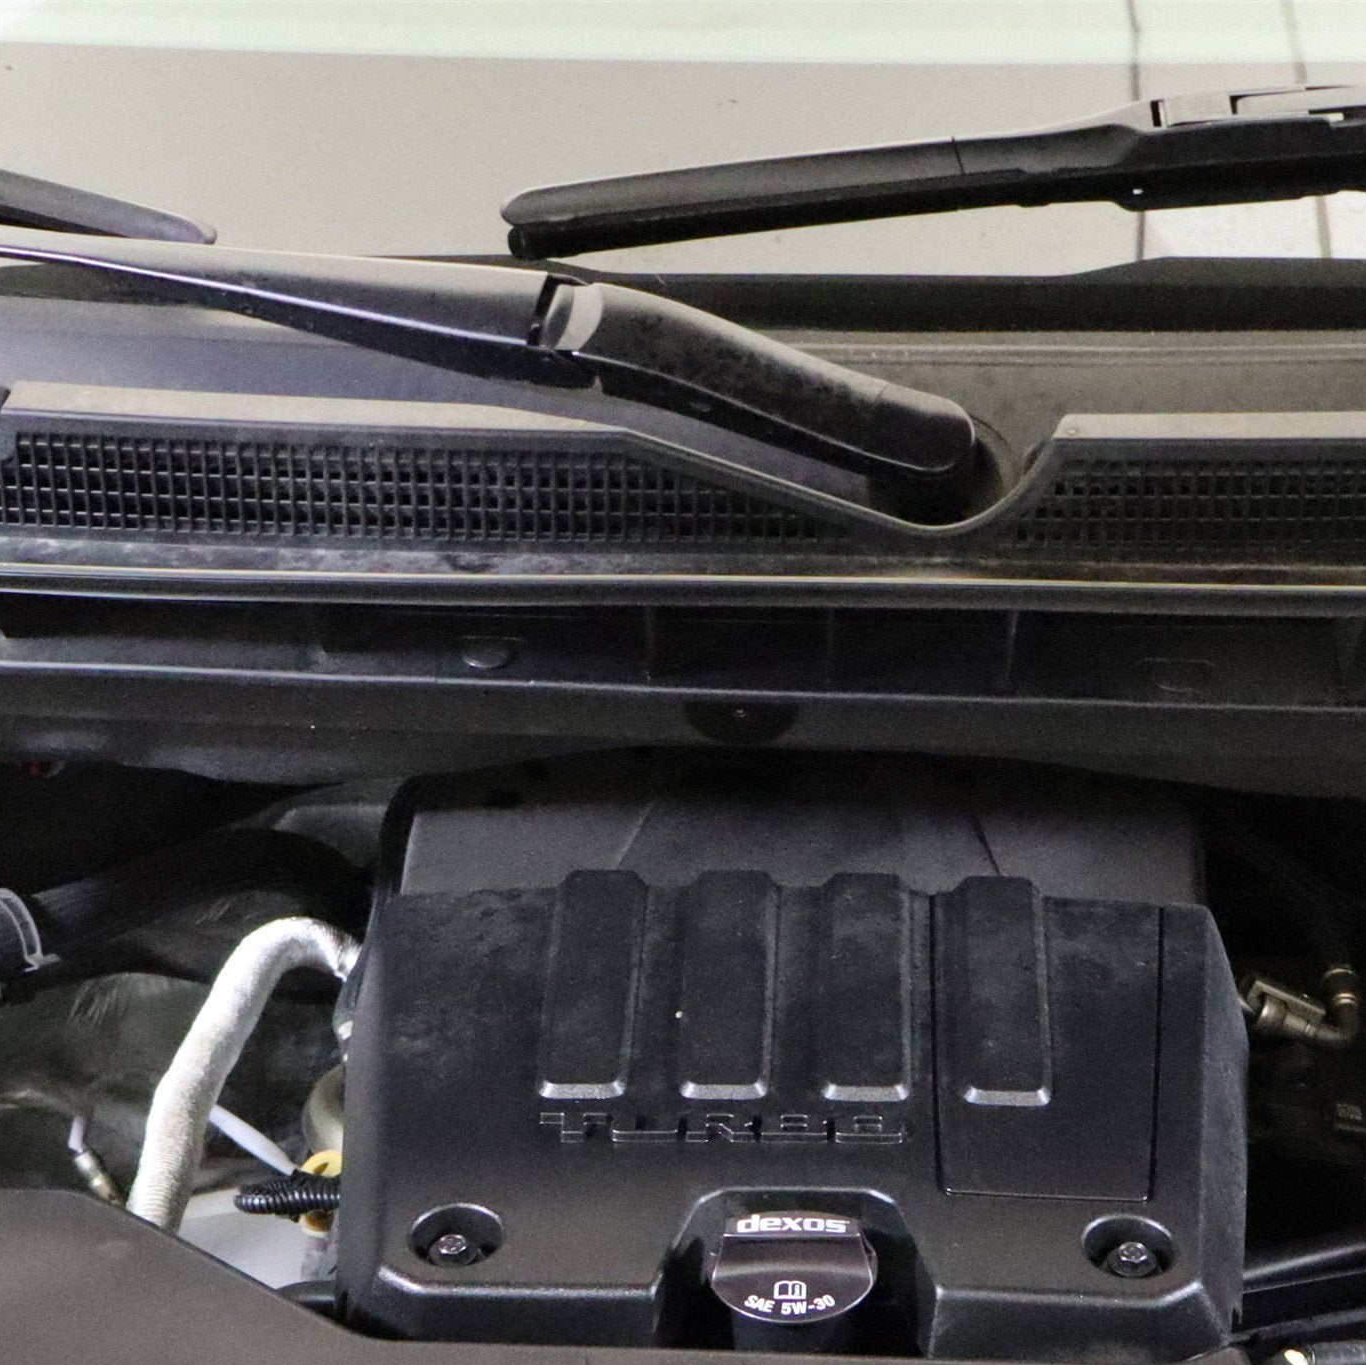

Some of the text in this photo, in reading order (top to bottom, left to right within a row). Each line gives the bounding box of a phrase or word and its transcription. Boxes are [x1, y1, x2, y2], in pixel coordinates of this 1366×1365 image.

[737, 1214, 847, 1233] dexos
[744, 1294, 835, 1315] SAE 5W-30
